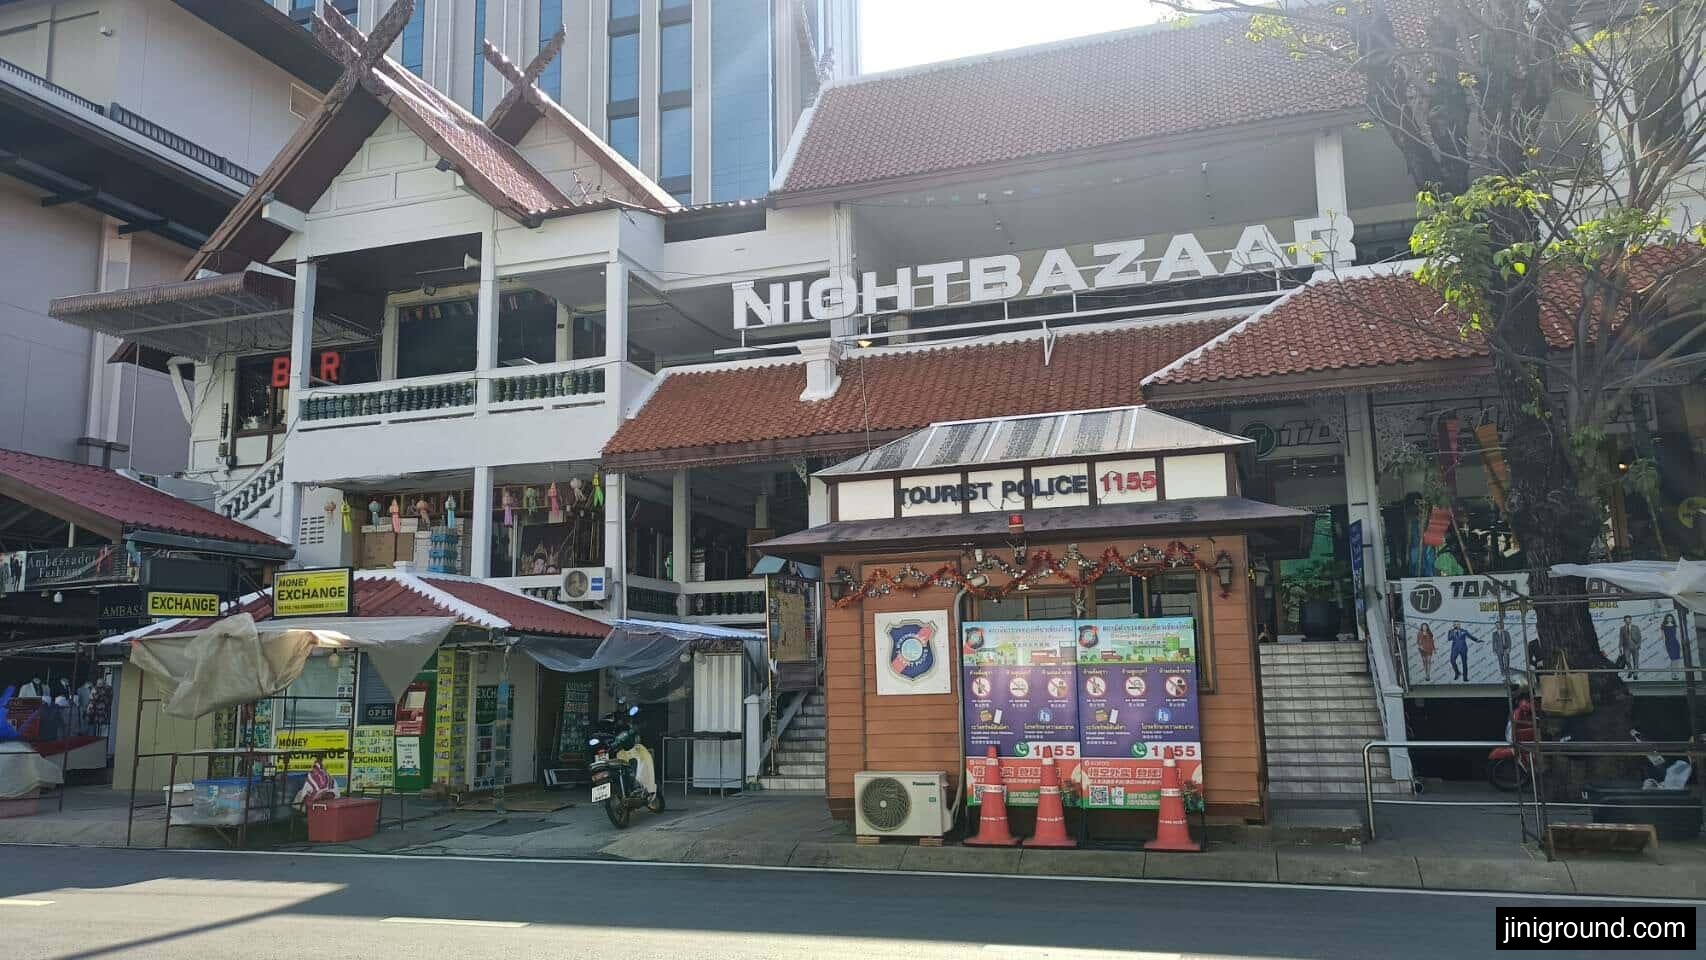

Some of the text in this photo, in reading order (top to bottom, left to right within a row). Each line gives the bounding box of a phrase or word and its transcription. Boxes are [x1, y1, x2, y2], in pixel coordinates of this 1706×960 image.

[272, 351, 340, 388] BR
[896, 470, 1157, 505] TOURIST POLICE 1155
[279, 577, 308, 588] MONEY
[278, 586, 345, 601] EXCHANGE
[151, 596, 216, 612] EXCHANGE
[279, 737, 308, 747] MONEY
[1034, 745, 1075, 757] 155
[1152, 745, 1196, 757] 155
[353, 755, 393, 764] EXCHANGE
